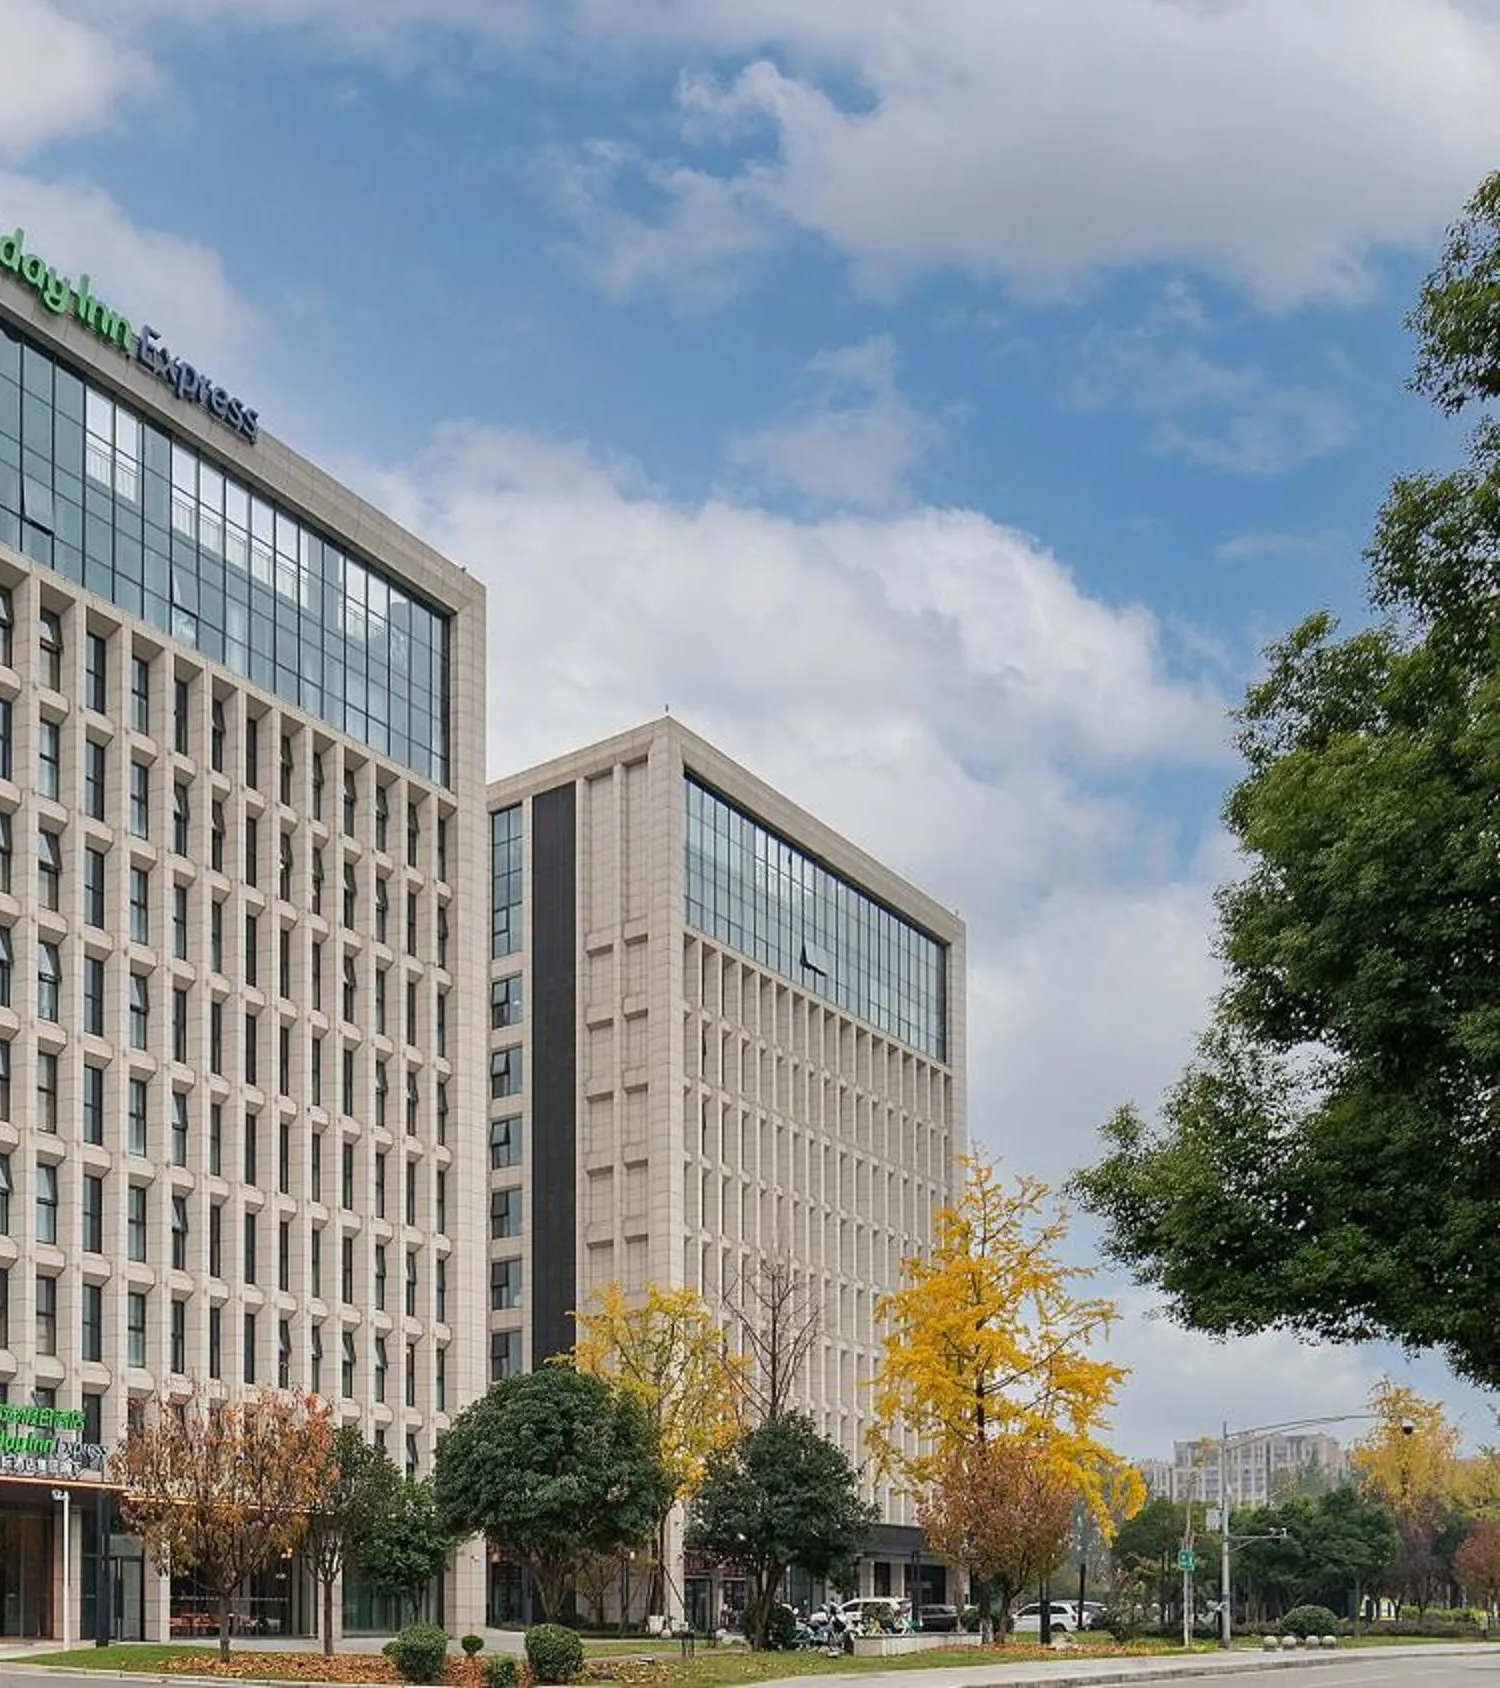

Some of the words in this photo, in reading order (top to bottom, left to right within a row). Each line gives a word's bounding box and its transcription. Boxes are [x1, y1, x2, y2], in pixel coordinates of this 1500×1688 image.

[75, 273, 133, 351] Inn
[135, 325, 259, 444] Express
[27, 1431, 54, 1456] Inn
[55, 1437, 108, 1460] Express
